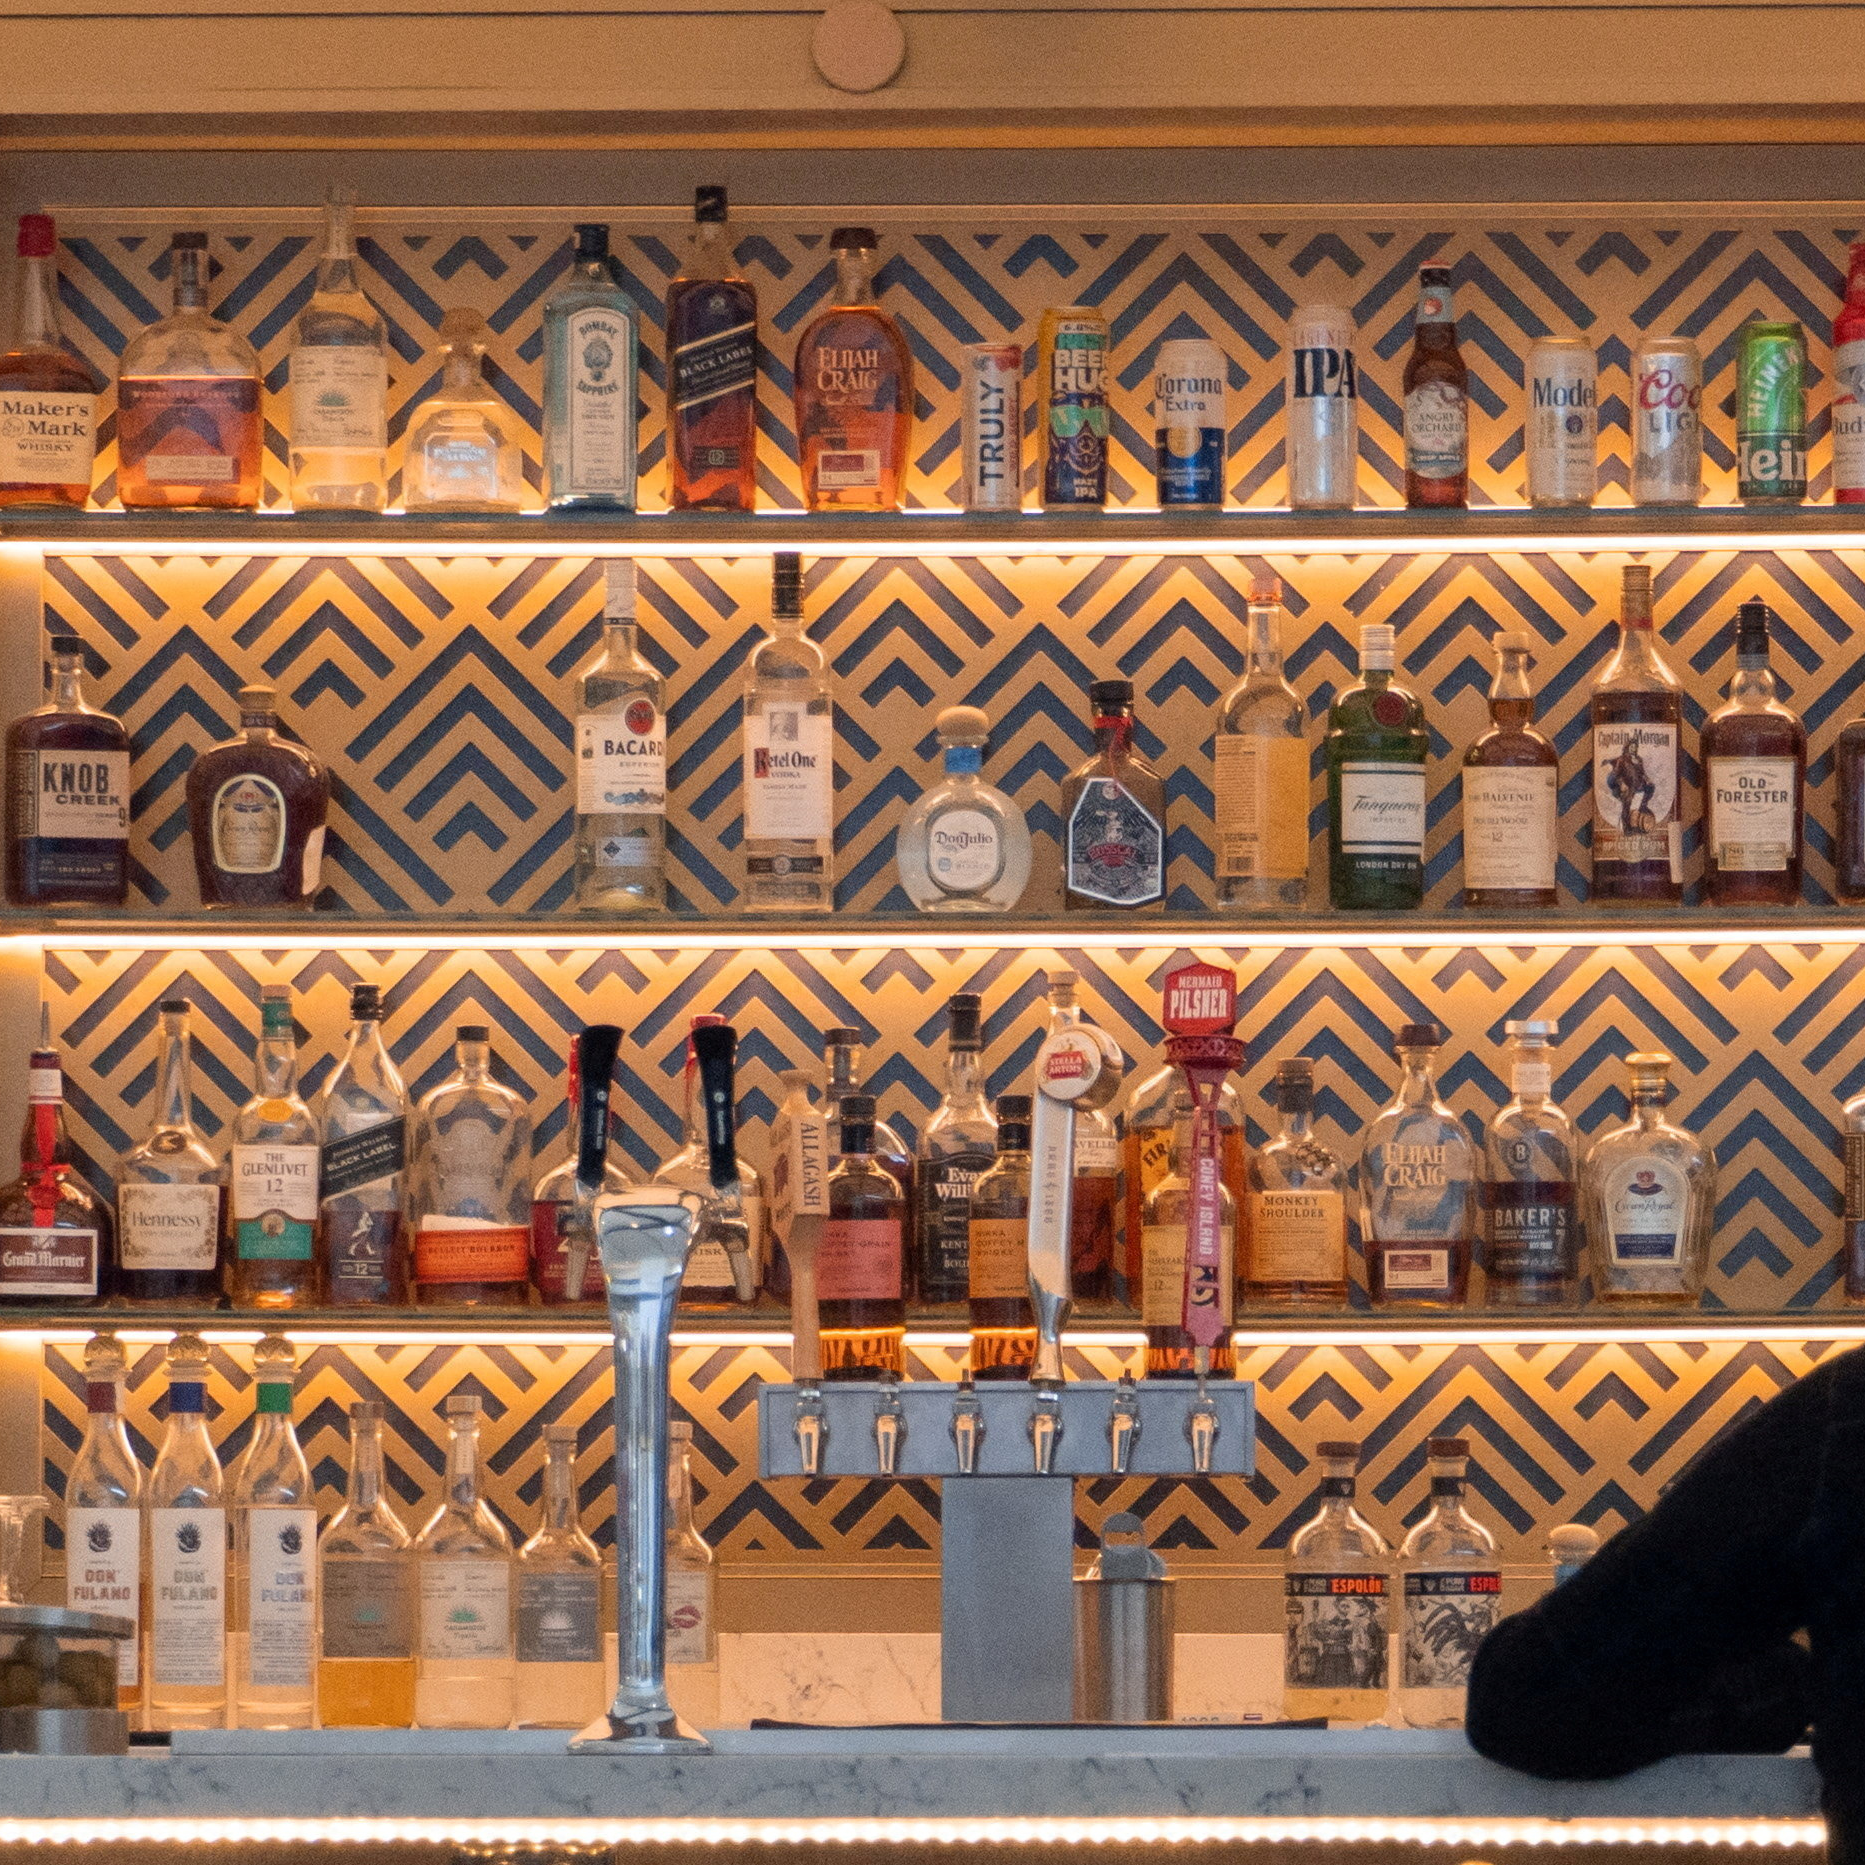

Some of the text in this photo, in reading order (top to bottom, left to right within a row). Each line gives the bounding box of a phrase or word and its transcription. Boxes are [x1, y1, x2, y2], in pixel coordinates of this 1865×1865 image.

[578, 321, 619, 338] BOMBAY
[679, 360, 716, 378] BLACK
[718, 346, 753, 364] LABEL
[818, 347, 879, 369] ELIJAH
[817, 369, 878, 393] CRAIG
[1293, 348, 1357, 399] IPA
[1155, 373, 1222, 400] Corona
[1, 400, 89, 417] Maker's
[1164, 397, 1207, 412] Extra
[27, 421, 87, 437] Mark
[979, 380, 1004, 488] TRULY
[17, 443, 74, 452] WHISKY
[1075, 487, 1099, 498] IPA
[1598, 729, 1670, 747] Captain Morgan
[754, 749, 816, 776] Ketel One
[43, 763, 109, 793] KNOB
[1738, 776, 1767, 789] OLD
[55, 794, 121, 806] CREEK
[1716, 789, 1789, 803] FORESTER
[117, 807, 127, 828] 9
[1355, 861, 1389, 870] LONDON
[1178, 975, 1223, 989] MERMAID
[1169, 989, 1228, 1019] PILSNER
[1050, 1056, 1082, 1066] STELLA
[265, 1152, 285, 1162] THE
[327, 1143, 397, 1172] BLACK LABEL
[1384, 1142, 1446, 1165] ELIJAH
[241, 1162, 308, 1177] GLENLIVET
[800, 1121, 822, 1208] ALLAGASH
[1384, 1165, 1446, 1189] CRAIG
[266, 1179, 283, 1193] 12
[1199, 1157, 1215, 1256] CONEY ISLAND
[1264, 1196, 1319, 1206] MONKEY
[132, 1212, 201, 1231] Hennessy
[1260, 1208, 1324, 1219] SHOULDER
[1495, 1208, 1566, 1228] BAKER'S
[1555, 1229, 1566, 1253] 7
[2, 1251, 86, 1268] Grand Marnier
[355, 1263, 368, 1275] 12
[85, 1569, 116, 1583] DON
[173, 1570, 205, 1584] DON
[275, 1572, 305, 1585] DON
[74, 1586, 131, 1601] FULANO
[160, 1586, 218, 1601] FULANO
